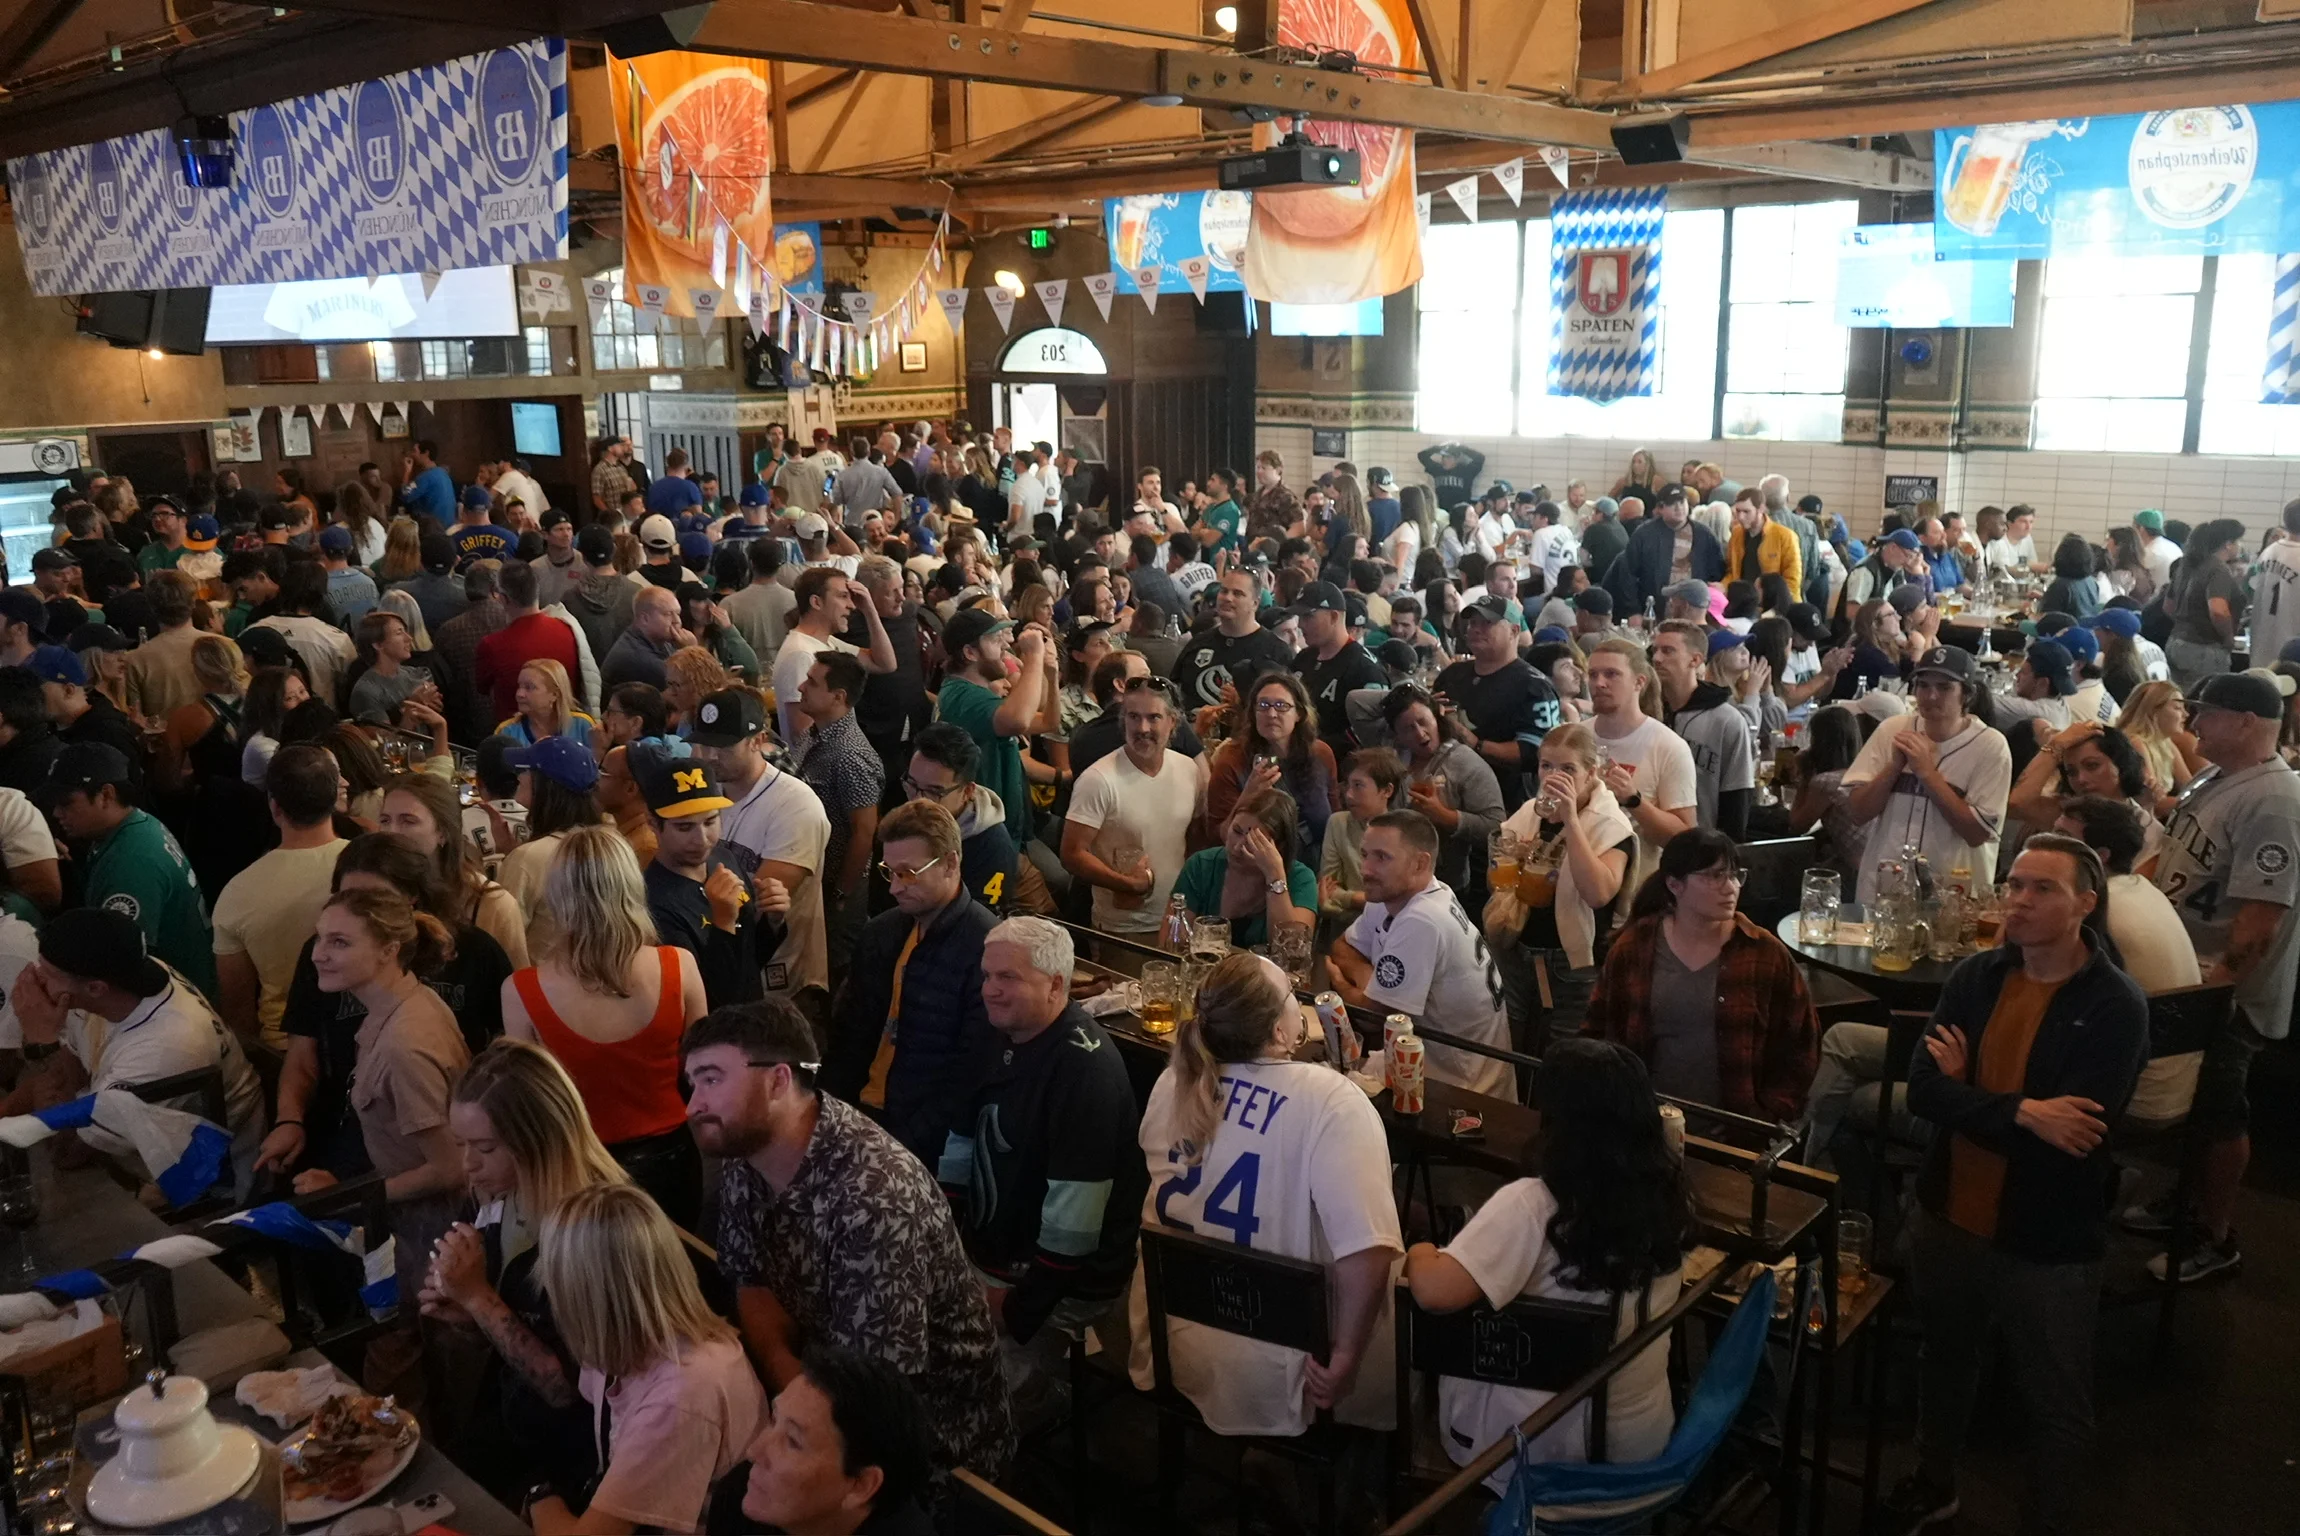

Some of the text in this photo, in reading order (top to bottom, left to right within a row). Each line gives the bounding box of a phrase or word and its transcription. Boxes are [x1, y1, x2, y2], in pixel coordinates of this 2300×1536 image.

[1570, 318, 1636, 333] SPATEN
[459, 534, 507, 552] GRIFFEY
[1932, 648, 1948, 665] S
[1320, 678, 1338, 702] A
[1532, 700, 1560, 729] 32
[672, 768, 708, 793] M
[983, 872, 1003, 900] 4
[1155, 1148, 1261, 1246] 24
